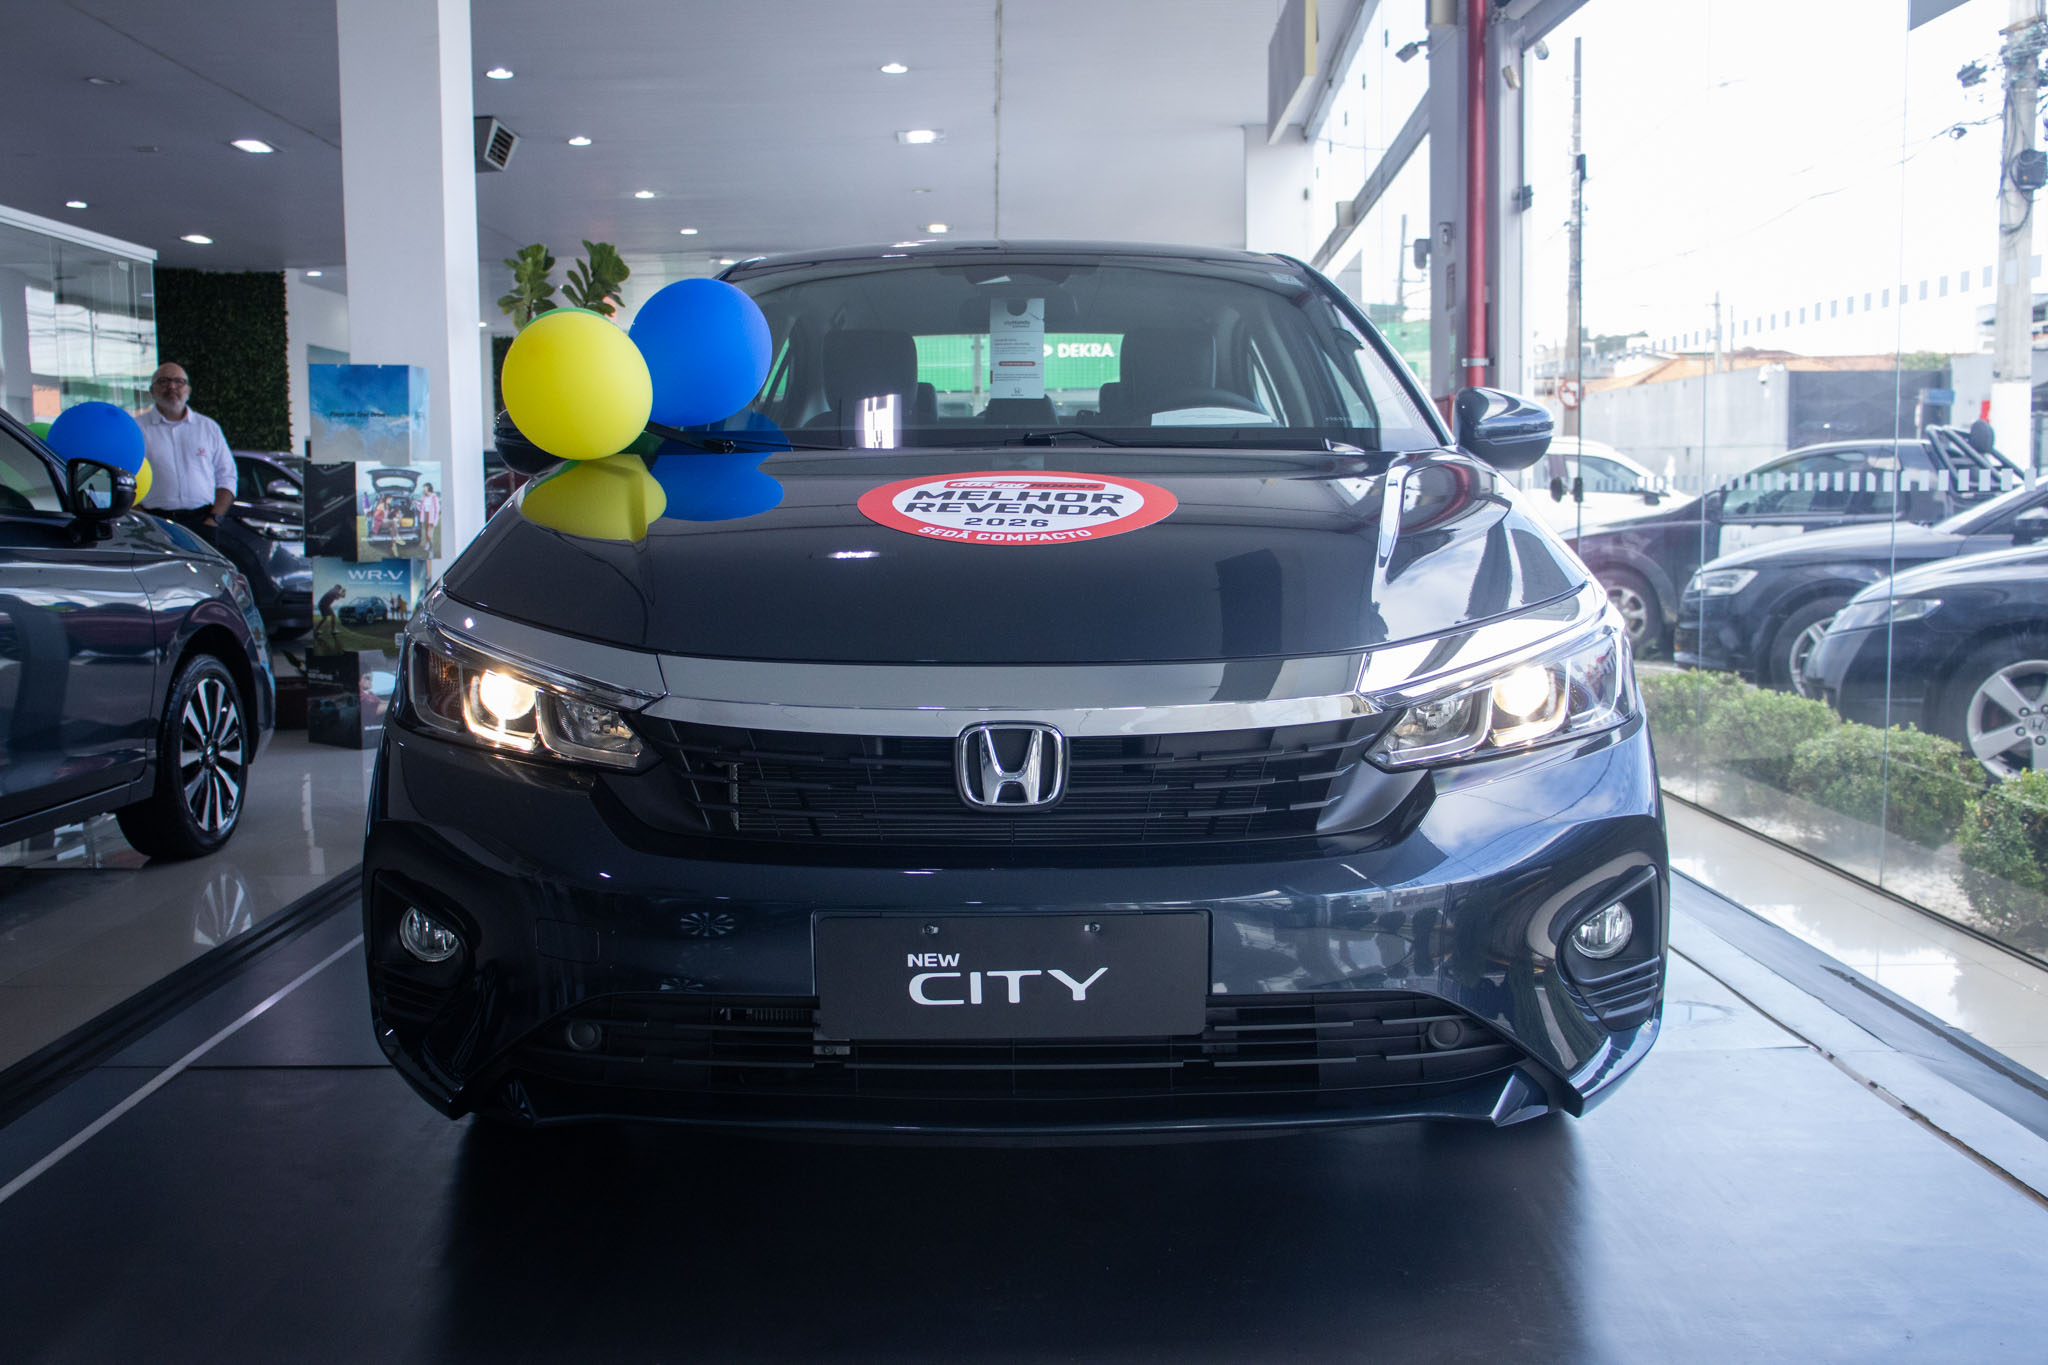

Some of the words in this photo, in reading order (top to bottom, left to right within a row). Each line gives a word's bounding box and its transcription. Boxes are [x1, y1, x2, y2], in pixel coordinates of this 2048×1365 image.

[1057, 342, 1115, 358] DEKRA
[912, 490, 1124, 504] MELHOR
[903, 502, 1120, 517] REVENDA
[964, 518, 1049, 527] 2026
[918, 526, 972, 539] SEDÃ
[976, 529, 1092, 542] COMPACTO
[348, 569, 404, 580] WR-V
[907, 953, 960, 967] NEW
[908, 967, 1109, 1006] CITY
